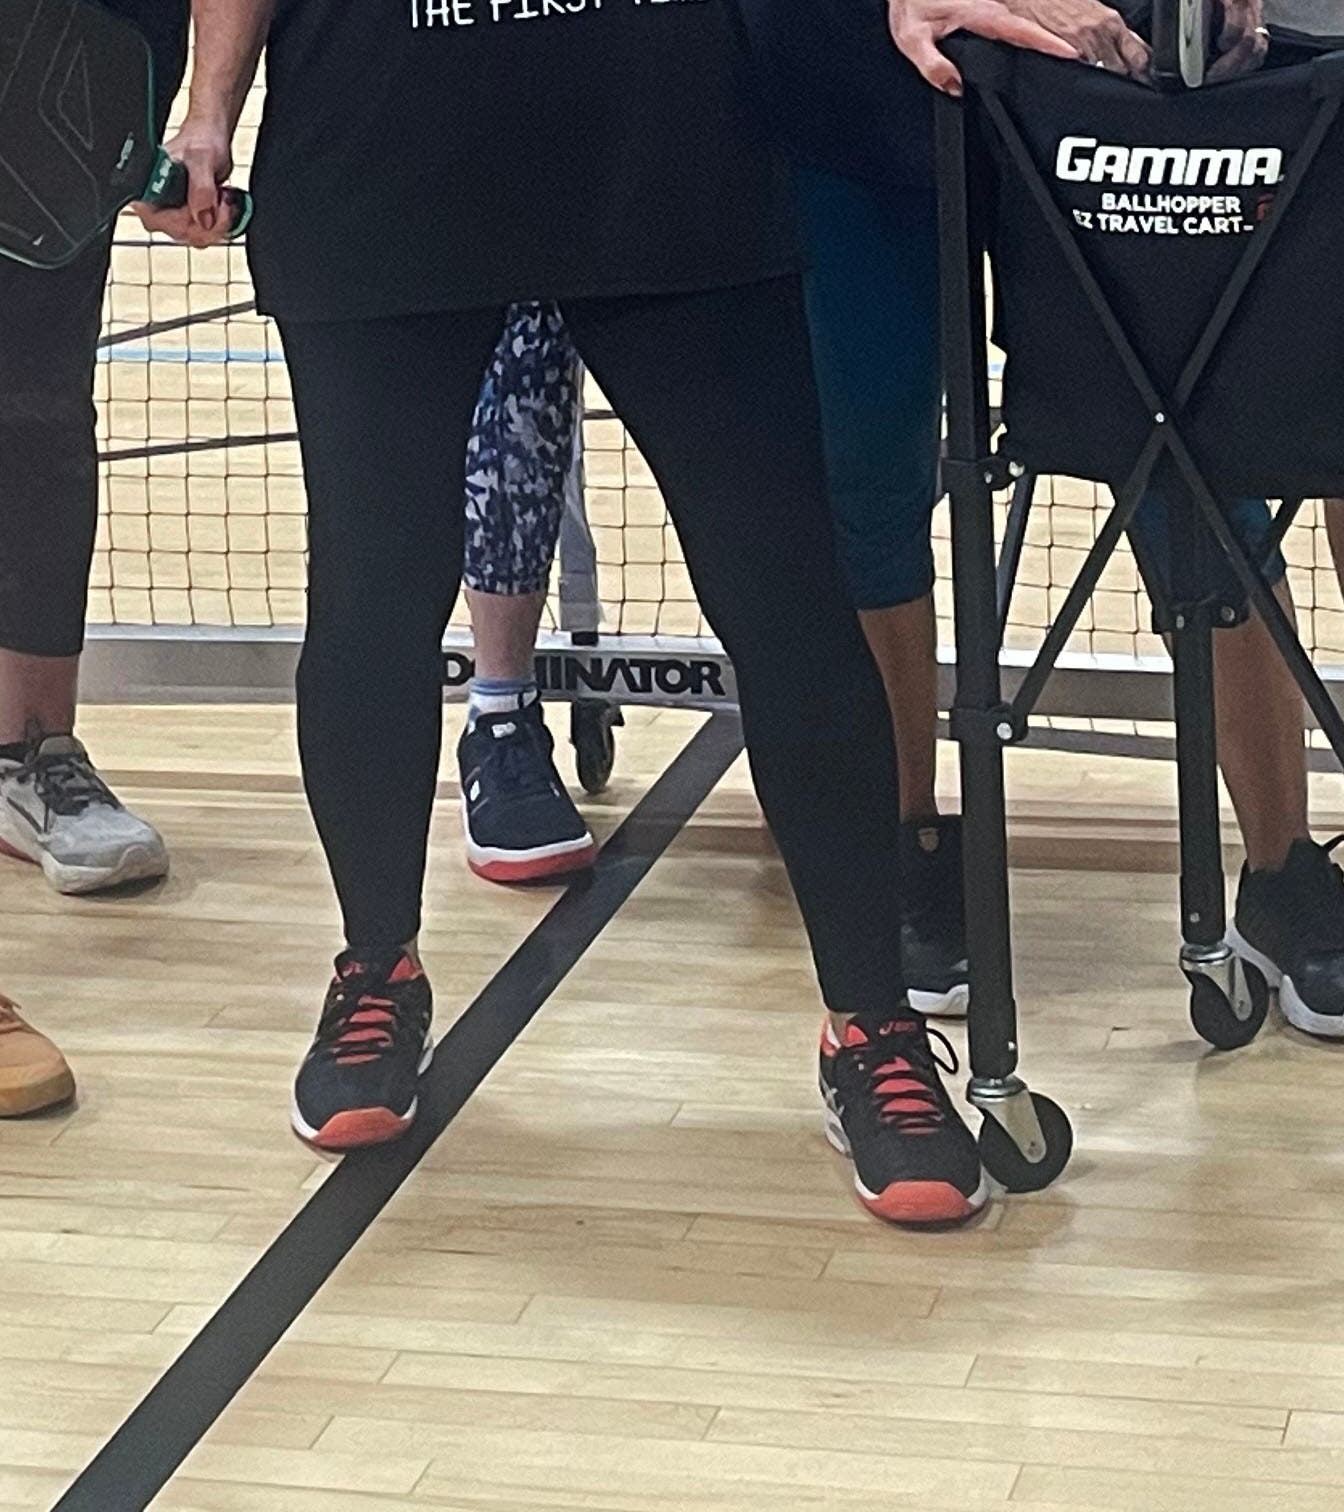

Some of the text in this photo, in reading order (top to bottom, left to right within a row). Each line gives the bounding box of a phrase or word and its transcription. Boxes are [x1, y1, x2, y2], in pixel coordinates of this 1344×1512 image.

[1056, 136, 1284, 186] GAMMA
[1102, 192, 1242, 214] BALLHOPPER
[1096, 213, 1179, 234] TRAVEL
[441, 652, 726, 696] DINATOR
